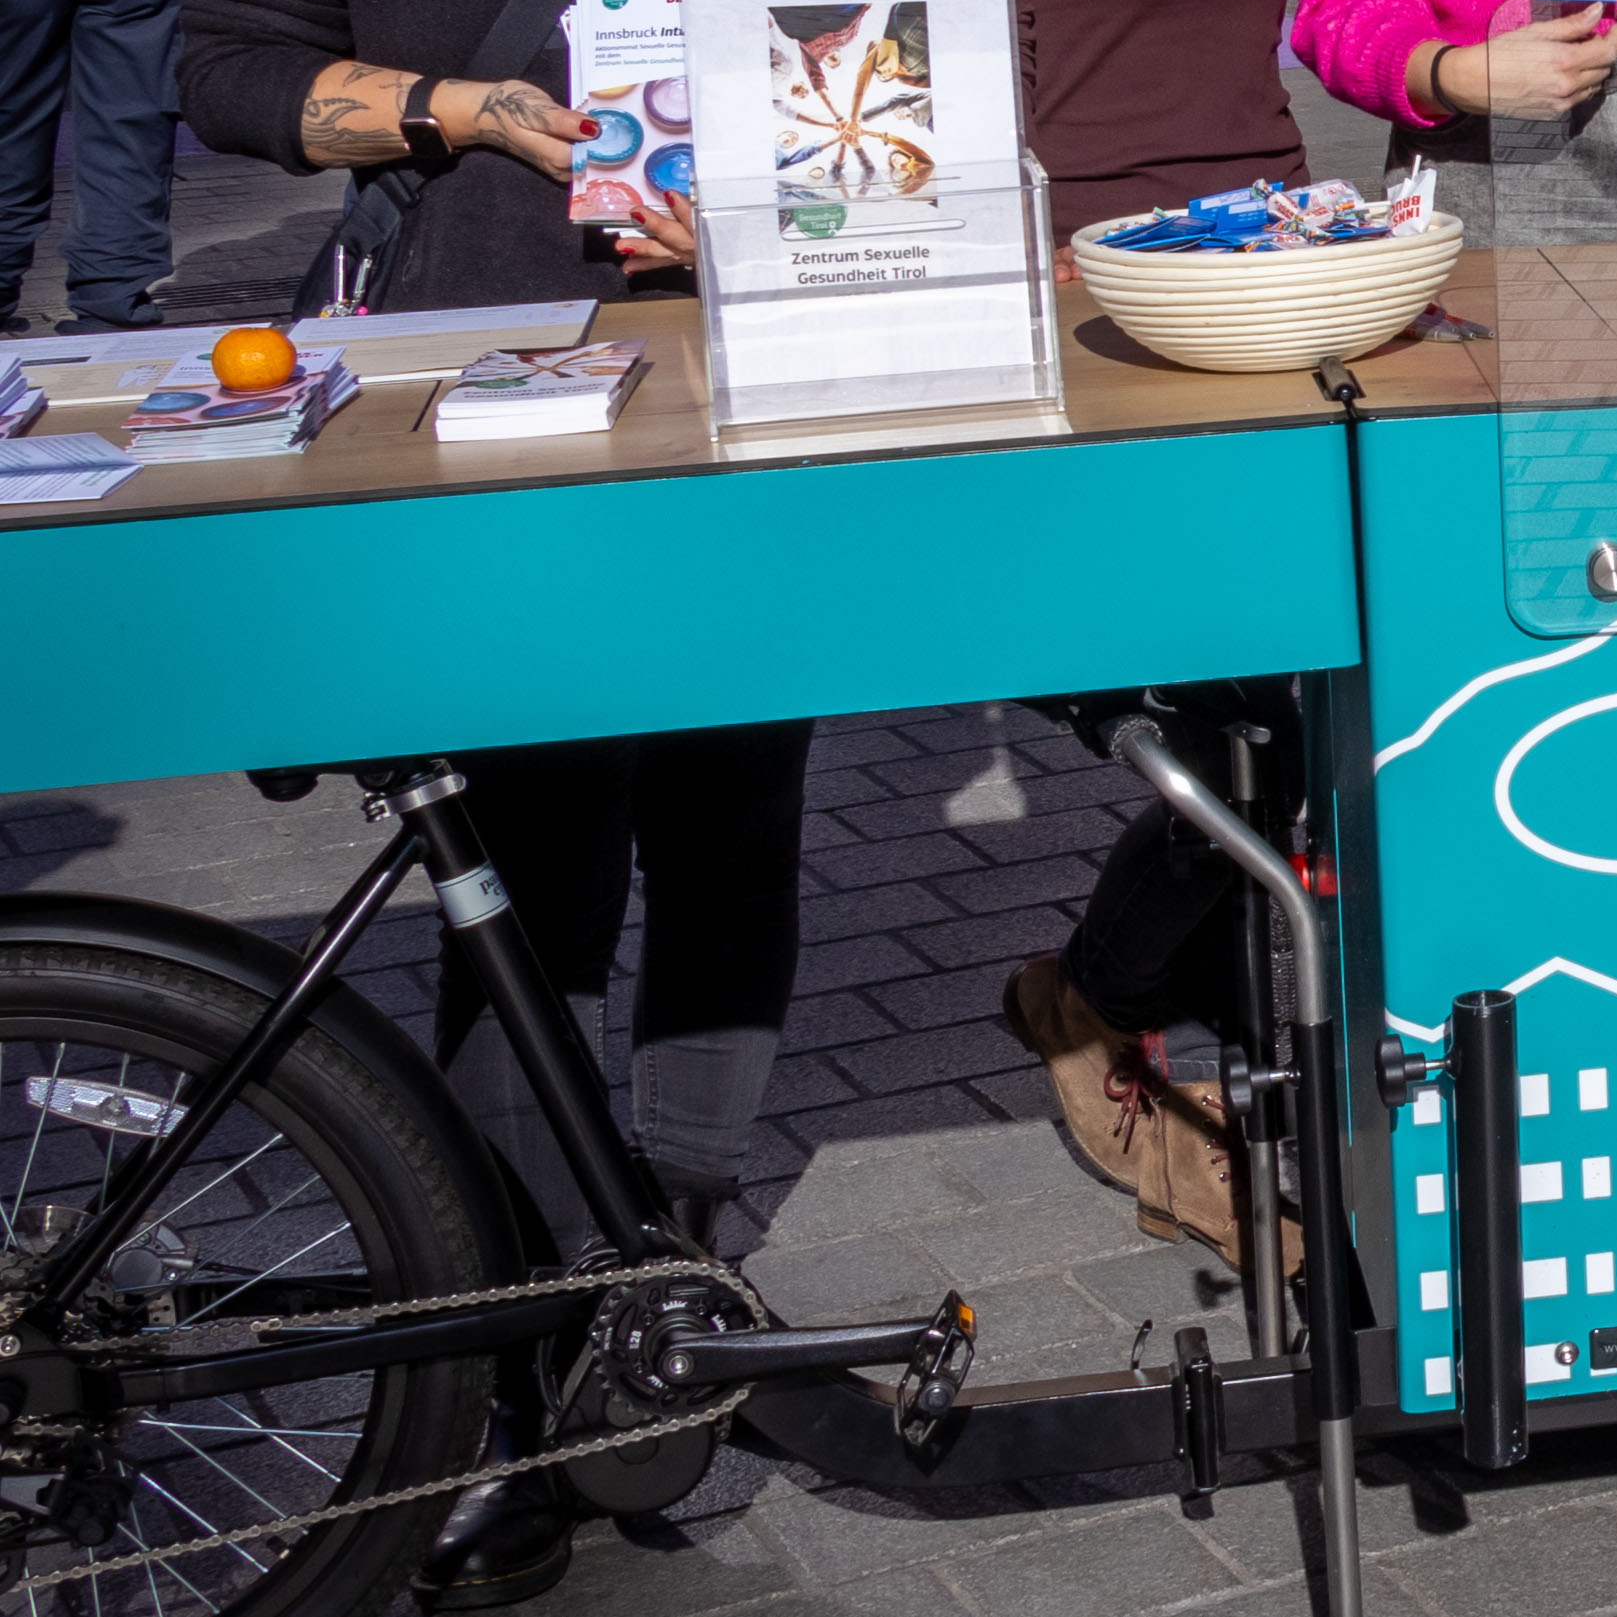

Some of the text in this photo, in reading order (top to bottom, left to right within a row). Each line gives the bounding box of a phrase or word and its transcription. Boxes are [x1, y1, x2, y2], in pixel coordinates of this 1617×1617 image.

[595, 27, 657, 40] Innsbruck
[791, 246, 930, 265] Zentrum Sexuelle
[797, 266, 927, 285] Gesundheit Tirol
